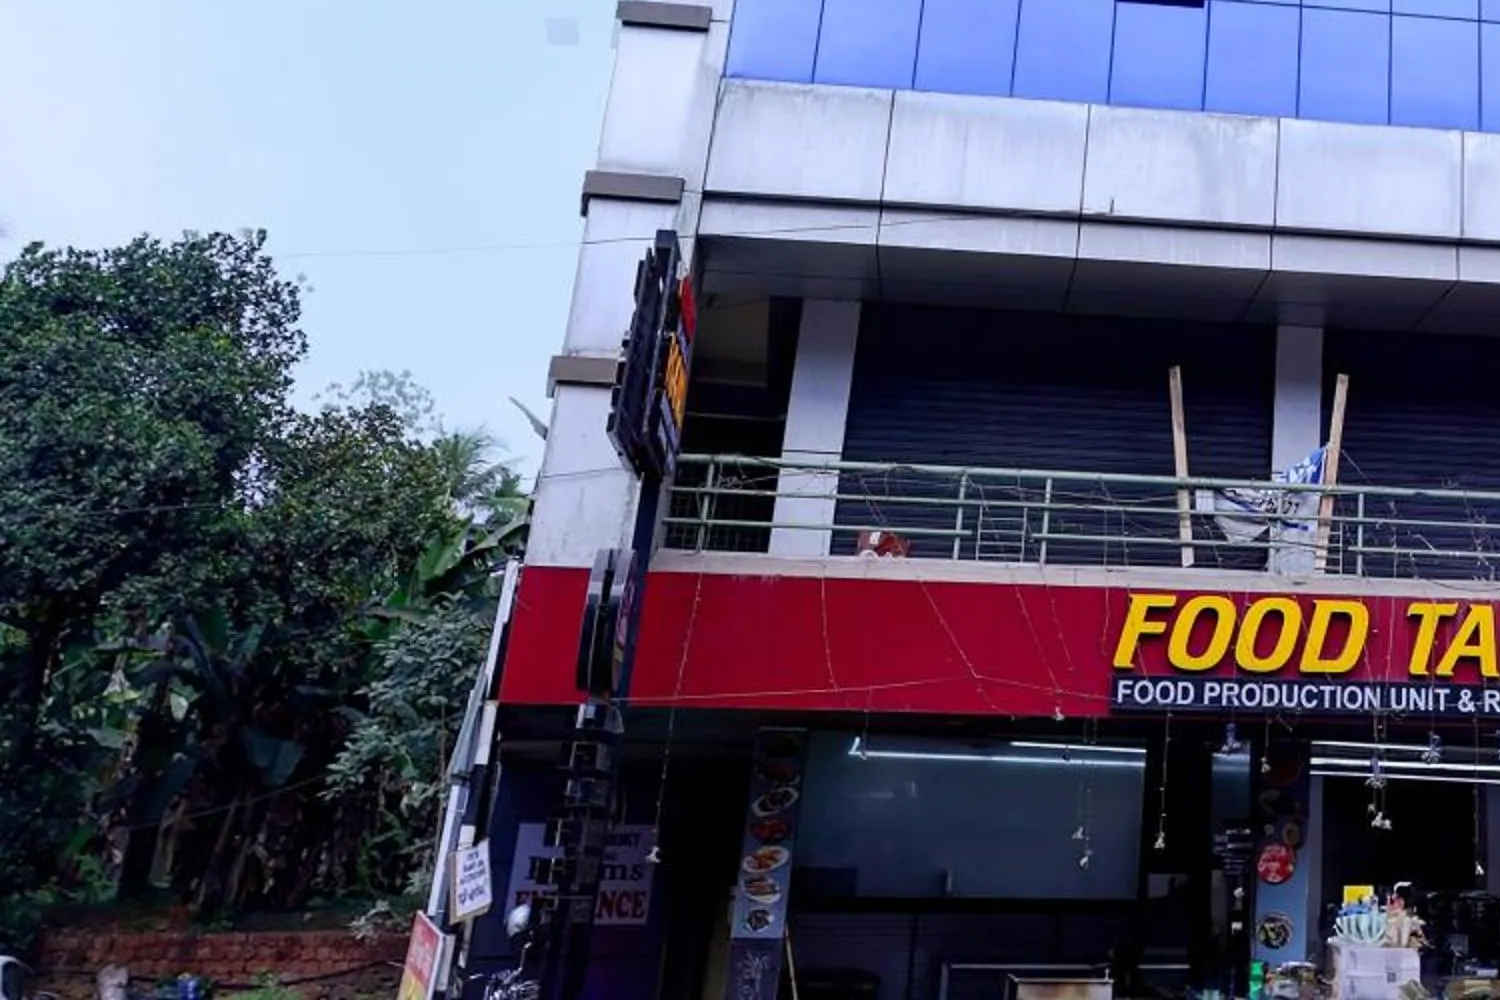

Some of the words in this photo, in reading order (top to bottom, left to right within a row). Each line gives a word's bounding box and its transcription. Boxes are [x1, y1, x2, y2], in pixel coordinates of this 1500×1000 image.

[1112, 593, 1370, 673] FOOD
[1116, 679, 1196, 707] FOOD
[1203, 682, 1381, 711] PRODUCTION
[1390, 687, 1452, 711] UNIT
[1457, 690, 1476, 713] &
